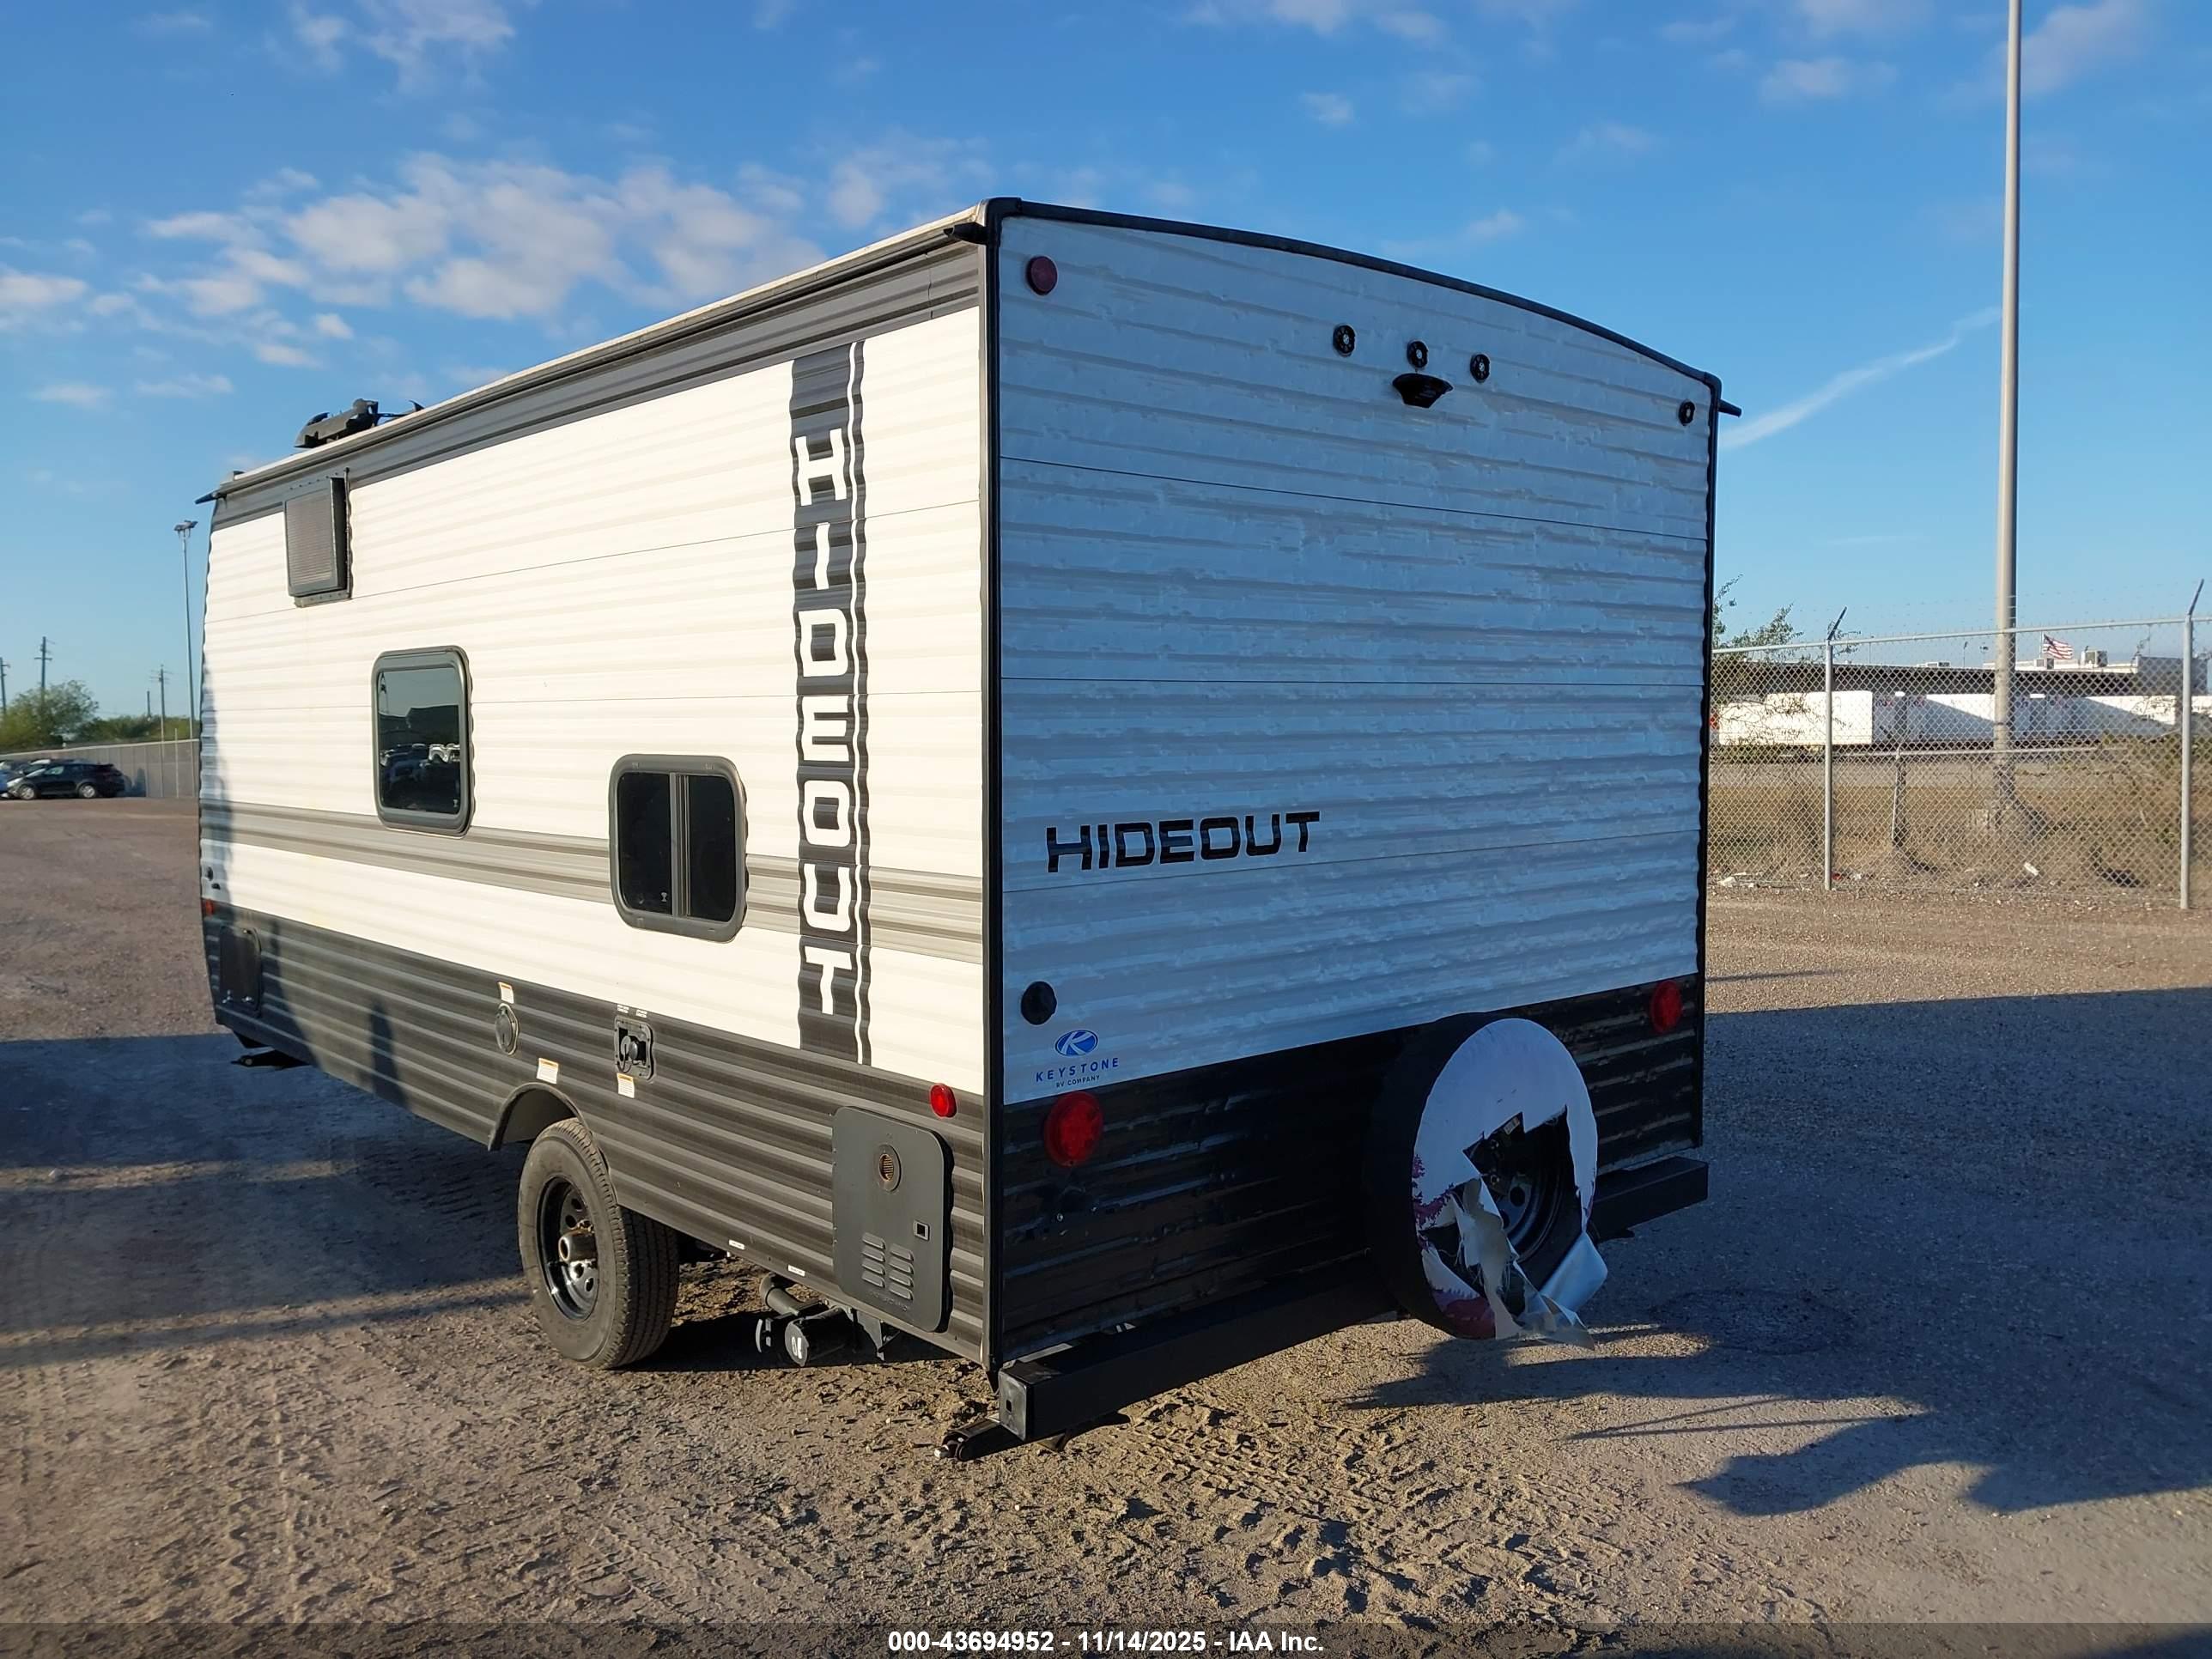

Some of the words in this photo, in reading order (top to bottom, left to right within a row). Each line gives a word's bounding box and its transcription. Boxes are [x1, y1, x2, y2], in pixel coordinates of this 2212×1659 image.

[794, 428, 853, 1016] HIDEOUT
[1046, 811, 1320, 873] HIDEOUT
[1035, 1057, 1120, 1082] KEYSTONE
[1067, 1074, 1100, 1086] COMPANY
